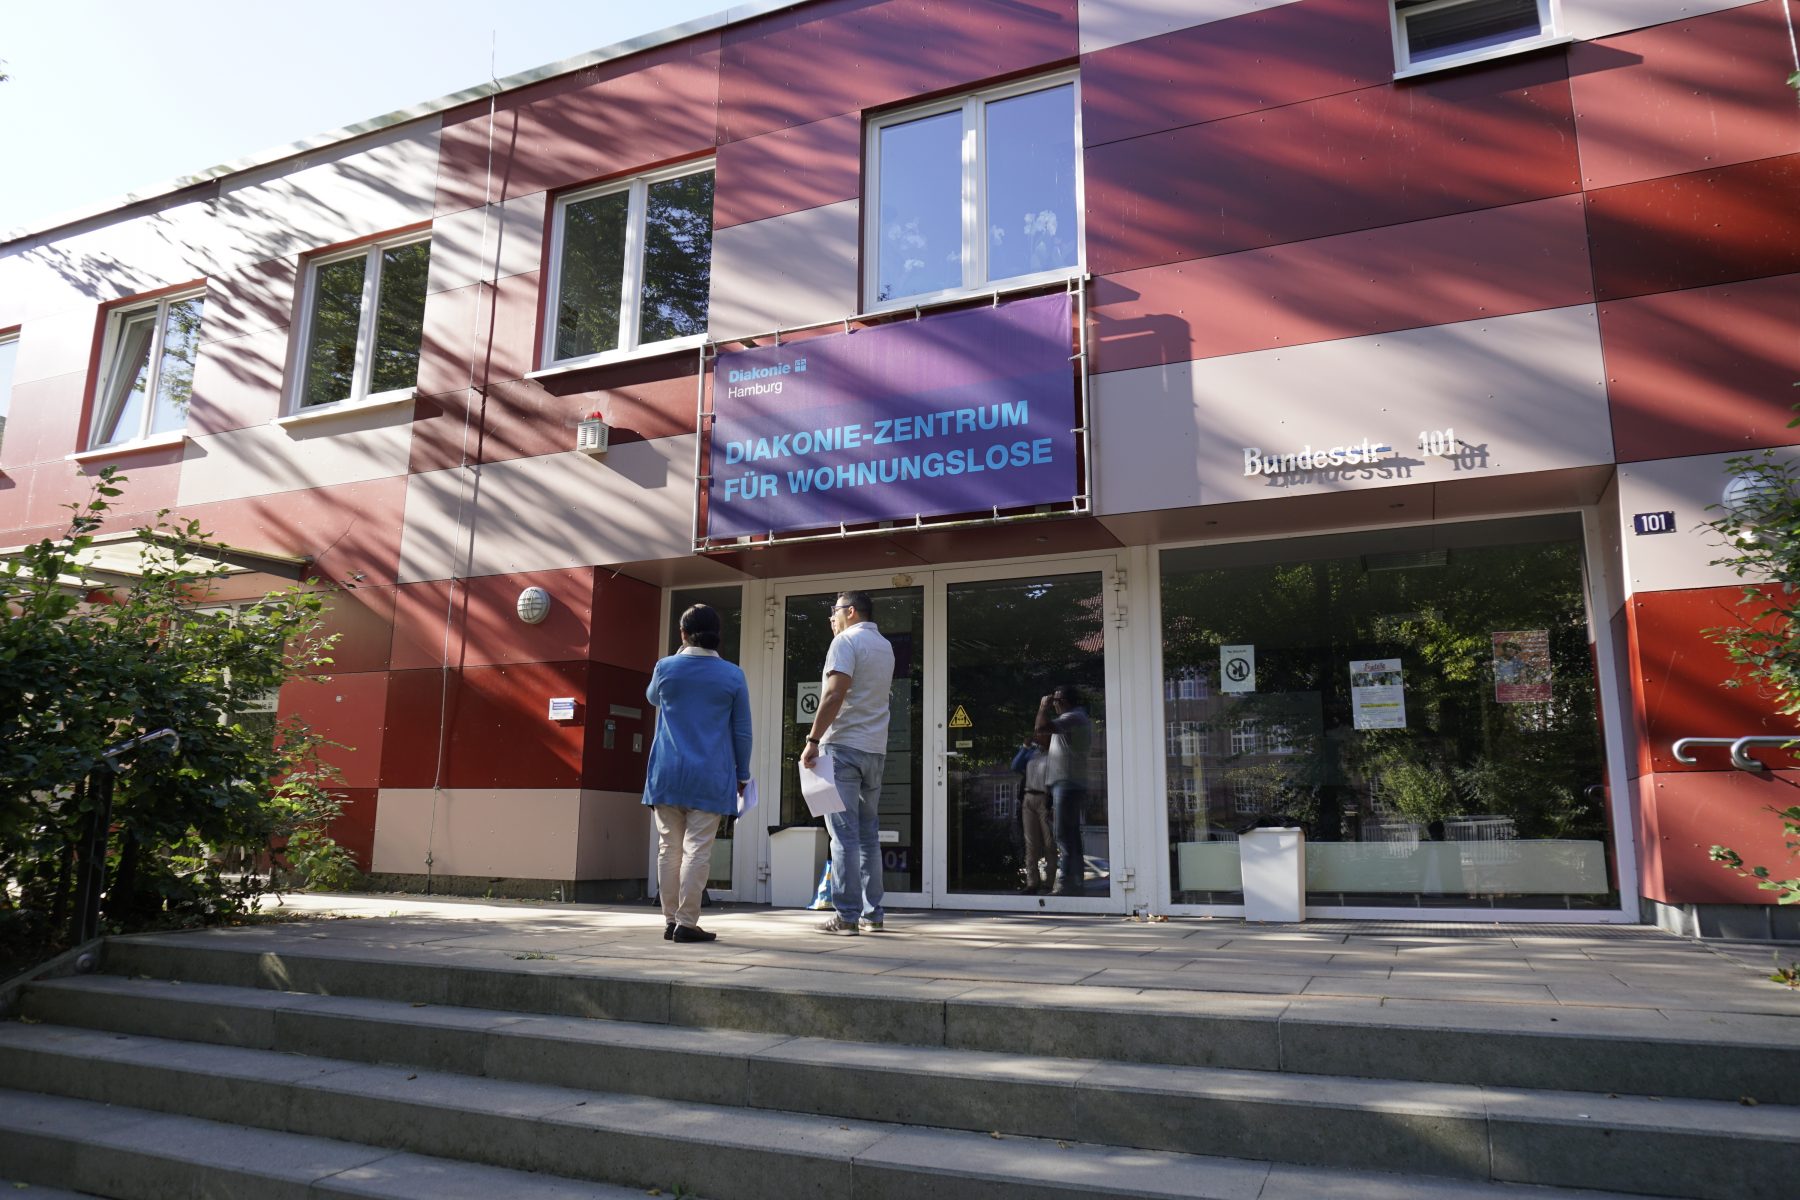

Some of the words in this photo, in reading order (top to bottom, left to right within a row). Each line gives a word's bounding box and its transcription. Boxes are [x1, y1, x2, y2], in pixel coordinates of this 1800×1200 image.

[728, 362, 791, 383] Diakonie
[728, 380, 783, 399] Hamburg
[725, 400, 1029, 465] DIAKONIE-ZENTRUM
[1418, 428, 1457, 457] 101
[724, 472, 778, 501] FÜR
[787, 438, 1053, 494] WOHNUNGSLOSE
[1641, 514, 1666, 532] 101
[884, 850, 908, 869] 01
